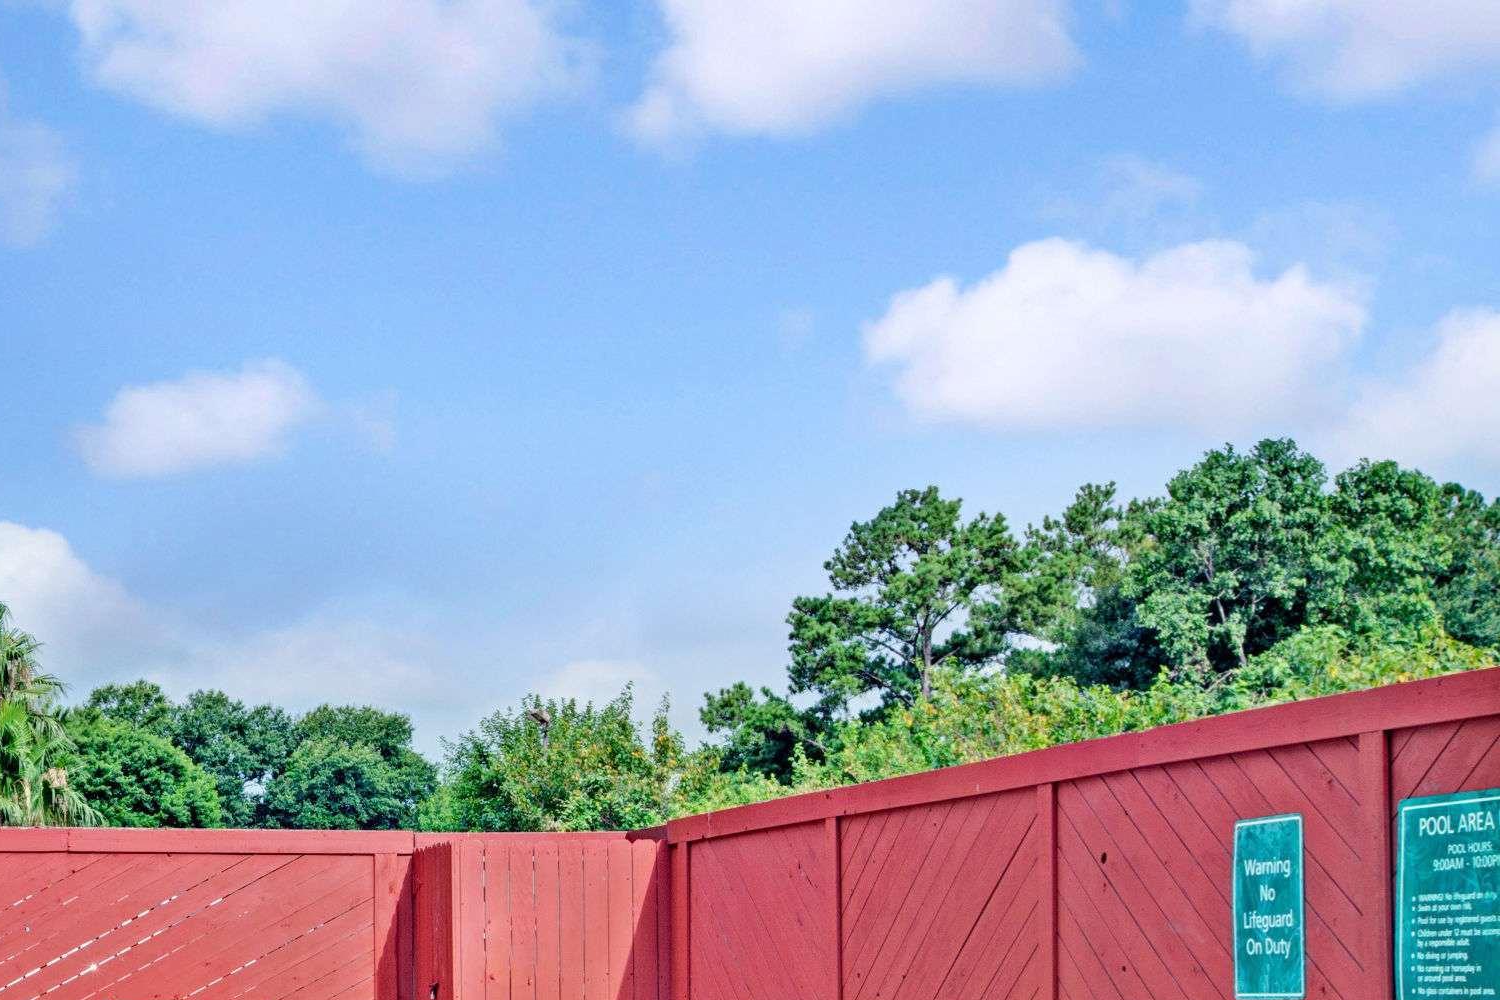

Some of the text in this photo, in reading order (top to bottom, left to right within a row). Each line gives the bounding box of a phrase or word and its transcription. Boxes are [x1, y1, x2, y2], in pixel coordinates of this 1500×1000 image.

[1419, 815, 1454, 837] POOL
[1458, 810, 1495, 833] AREA
[1243, 856, 1291, 878] Warning
[1259, 884, 1276, 902] No
[1243, 909, 1293, 933] Lifeguard
[1245, 937, 1291, 959] On Duty
